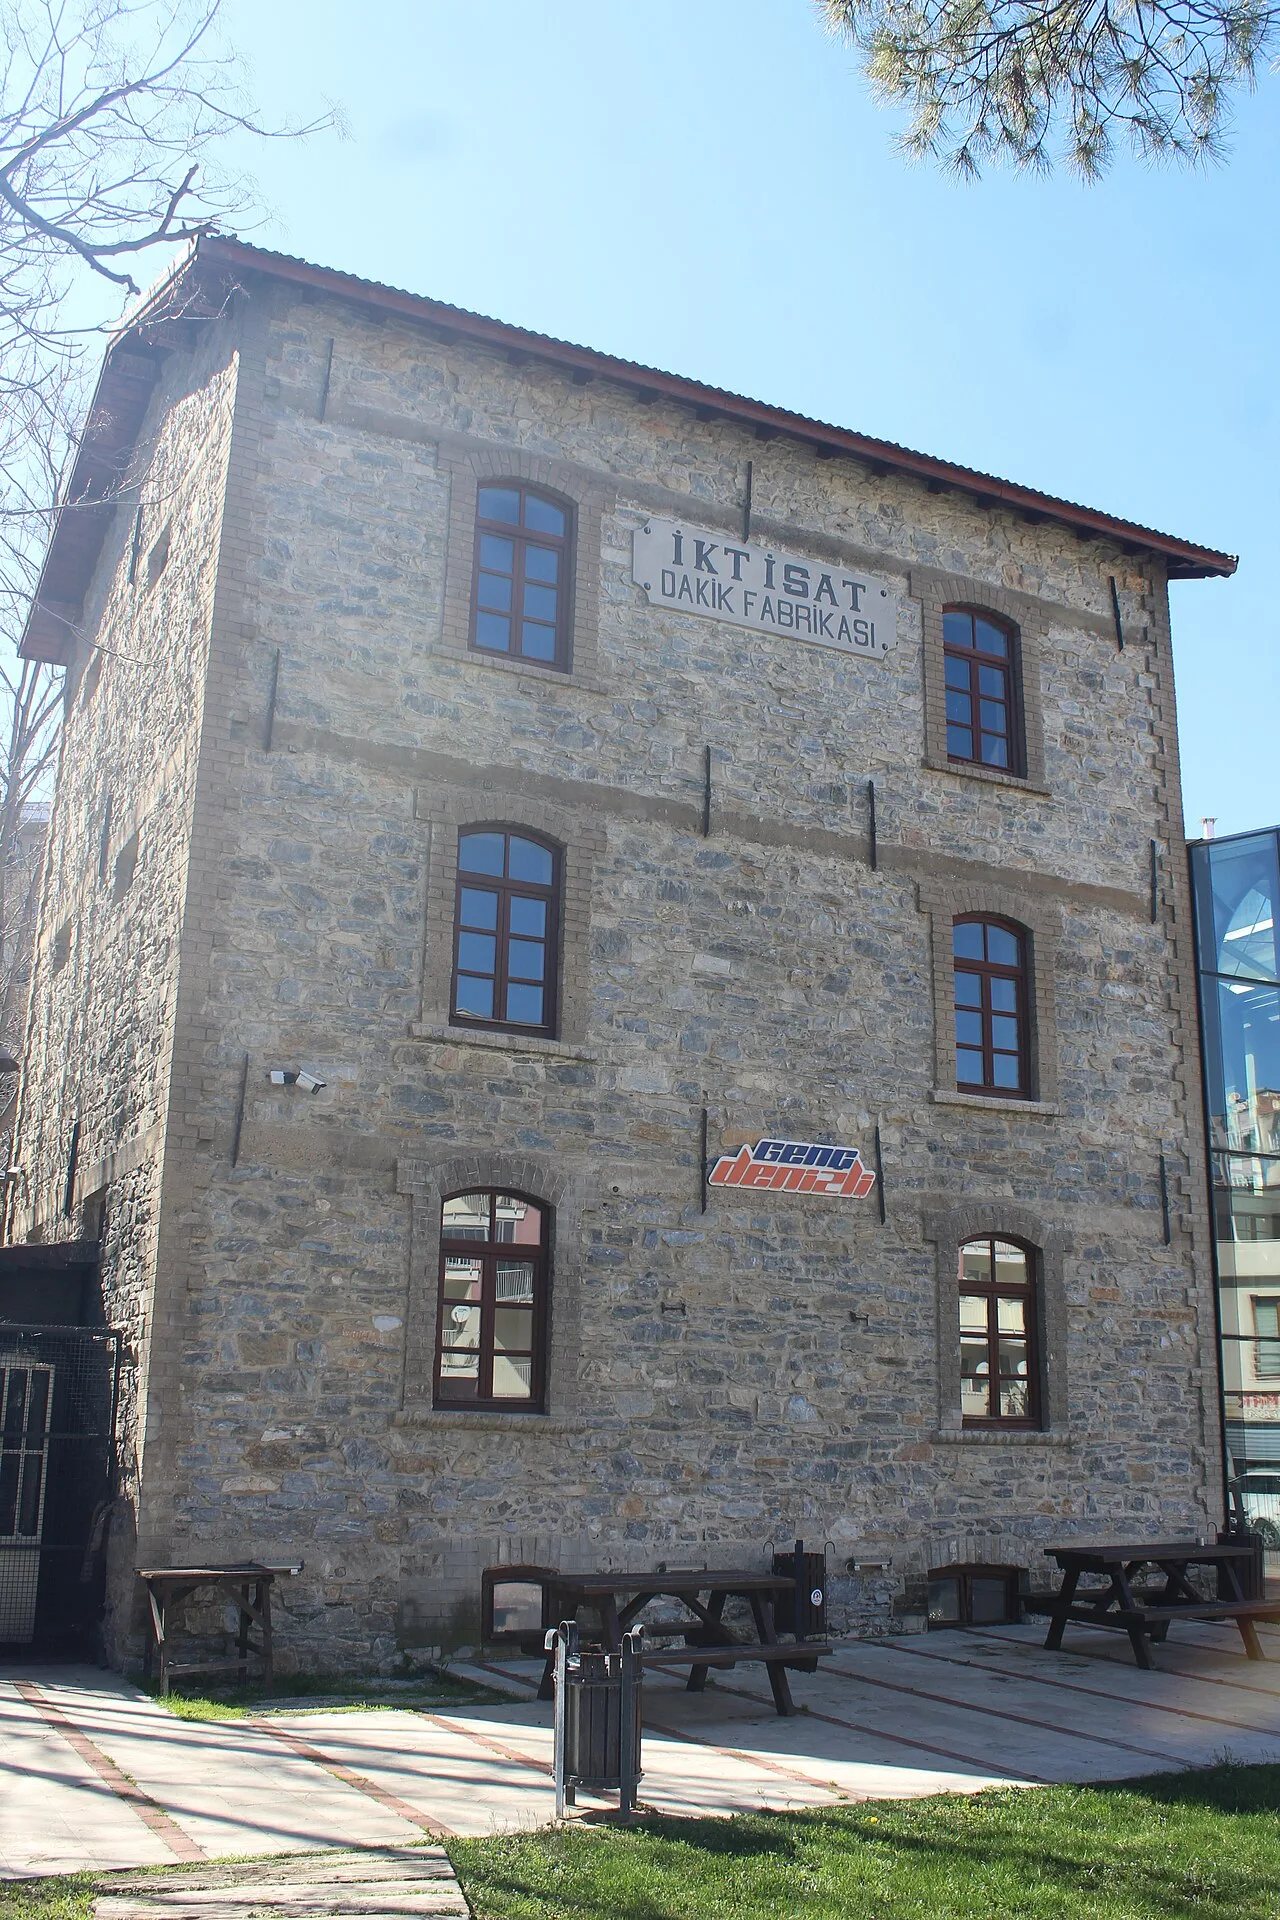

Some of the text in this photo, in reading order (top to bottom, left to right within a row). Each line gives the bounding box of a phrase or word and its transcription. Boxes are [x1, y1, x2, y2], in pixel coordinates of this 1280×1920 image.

[661, 569, 877, 649] DAKİK FABRİKASI
[671, 530, 866, 613] İKTİSAT
[710, 1147, 875, 1197] denizli
